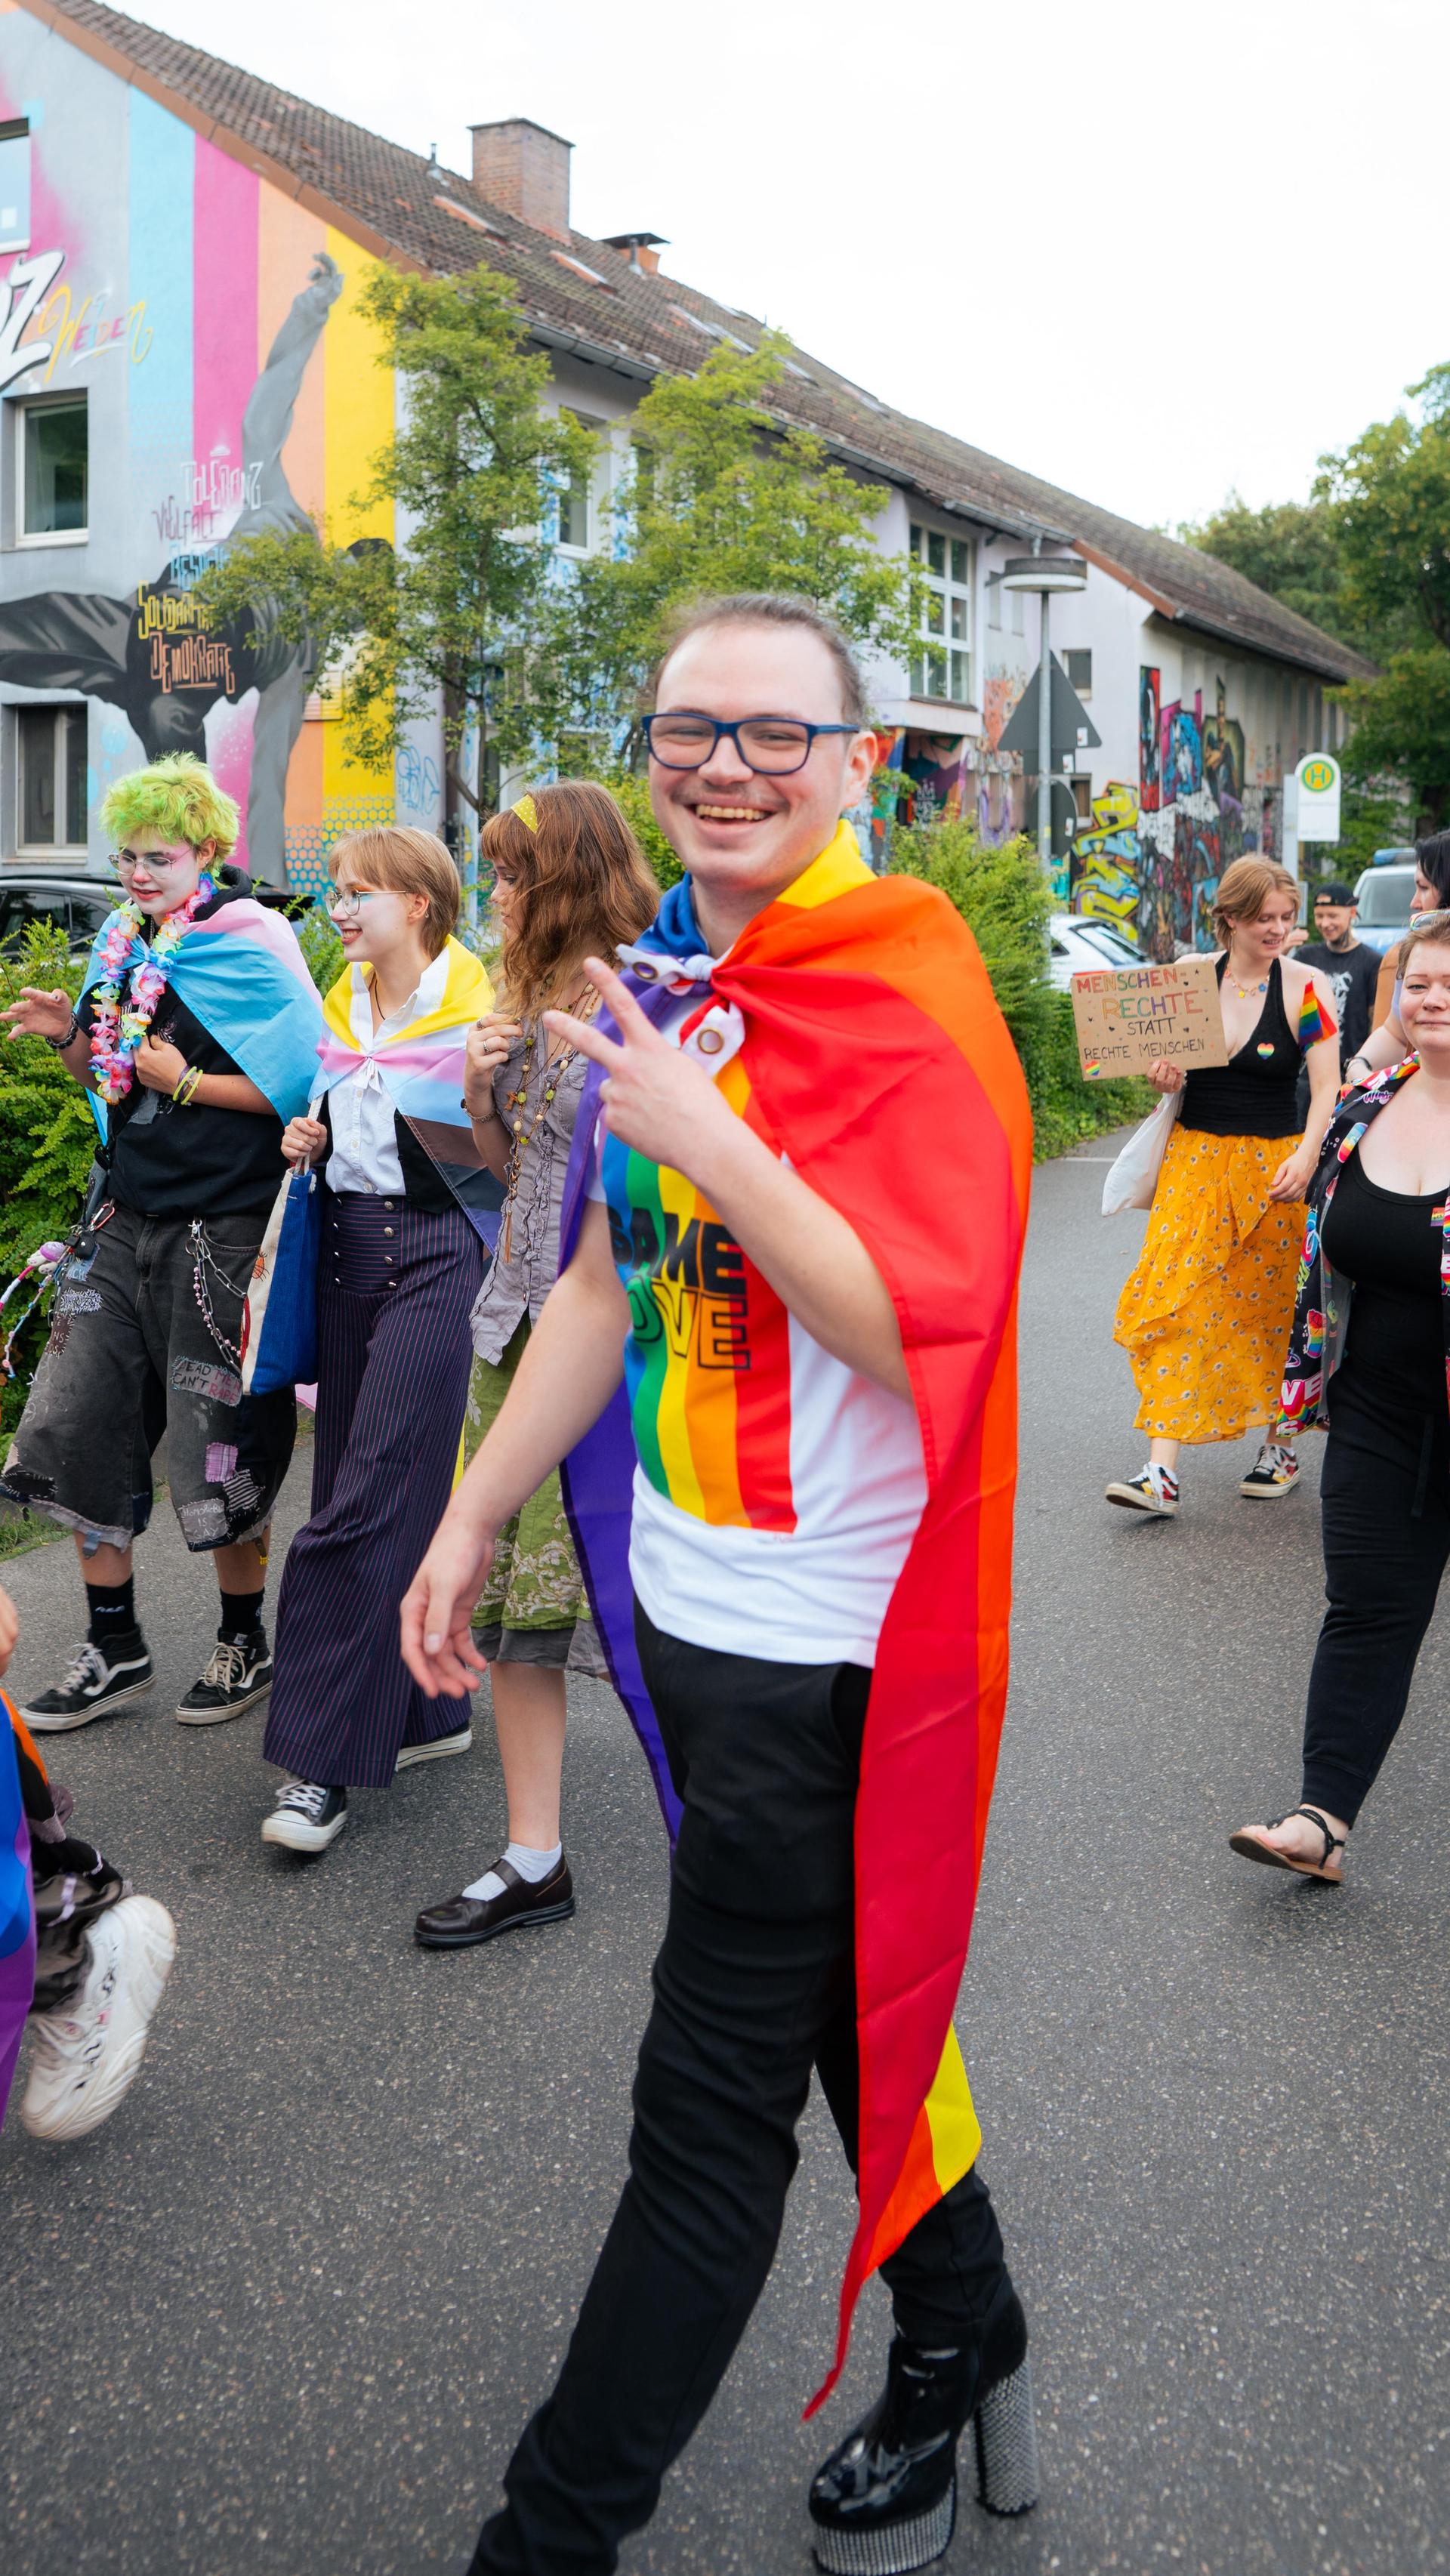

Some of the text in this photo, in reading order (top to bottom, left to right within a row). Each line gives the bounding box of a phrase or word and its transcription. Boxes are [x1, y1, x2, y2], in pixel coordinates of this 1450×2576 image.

[180, 458, 264, 511] TOLERANZ
[150, 631, 236, 695] DEMOKRATIE
[1077, 968, 1186, 994] MENSCHEN-
[1102, 990, 1203, 1020] RECHTE
[1127, 1017, 1176, 1035] STATT
[1084, 1038, 1205, 1060] RECHTE MENSCHEN
[628, 1276, 751, 1371] OVE
[174, 1373, 239, 1405] CAN'T RAPE
[176, 1361, 242, 1392] DEAD MEN
[193, 1527, 219, 1540] GAY
[198, 1517, 208, 1527] IS
